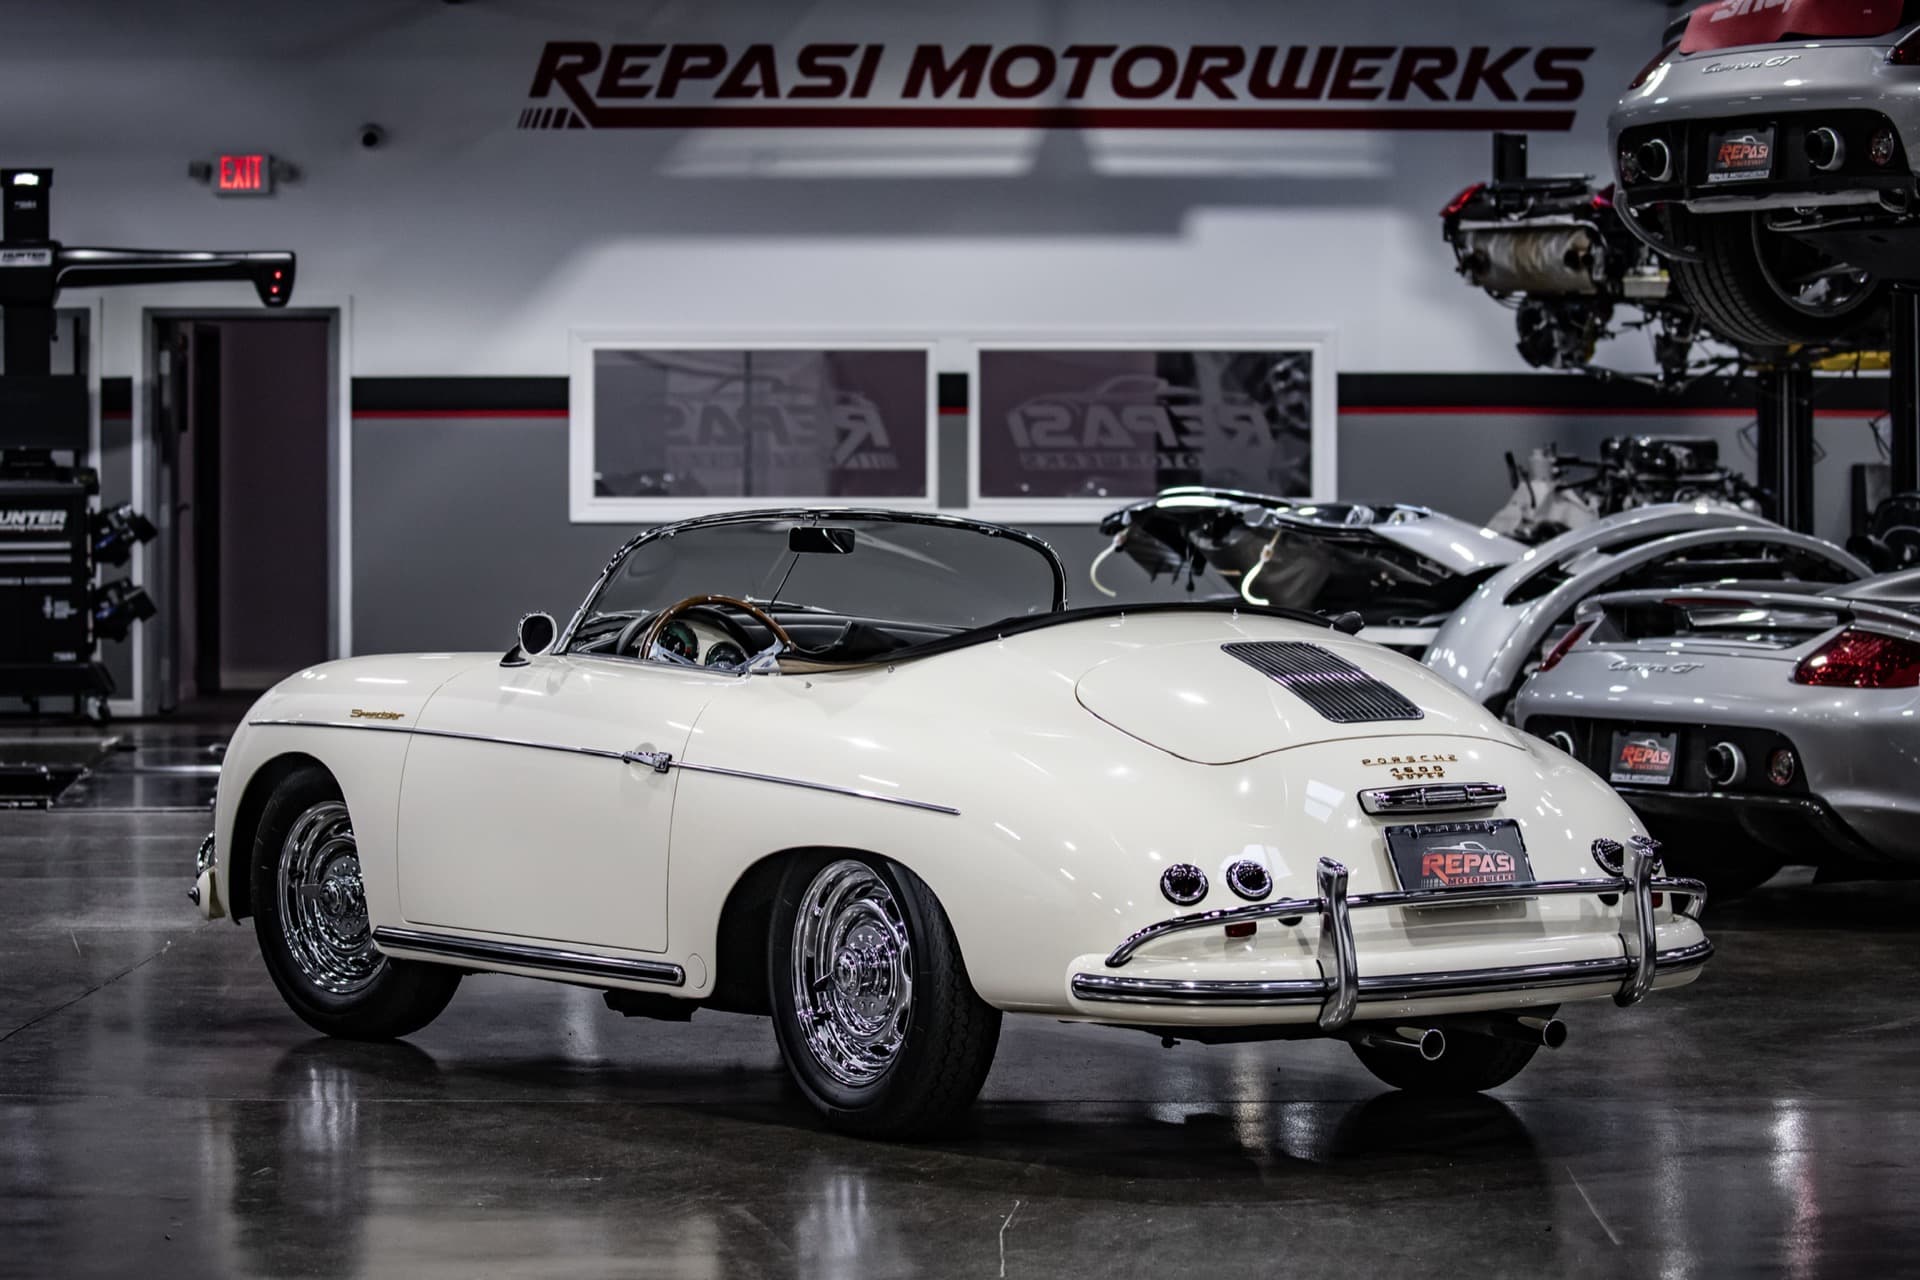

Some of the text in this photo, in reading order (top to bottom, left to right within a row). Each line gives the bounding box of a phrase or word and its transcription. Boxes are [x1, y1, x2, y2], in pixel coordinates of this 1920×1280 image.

[1764, 55, 1801, 67] GT
[529, 42, 1596, 106] REPASI MOTORWERKS
[1718, 144, 1769, 164] REPASI
[219, 155, 263, 190] EXIT
[1670, 662, 1705, 674] GT
[1362, 753, 1457, 765] PORSCHE
[1620, 745, 1671, 766] REPASI
[1422, 853, 1515, 880] REPASI
